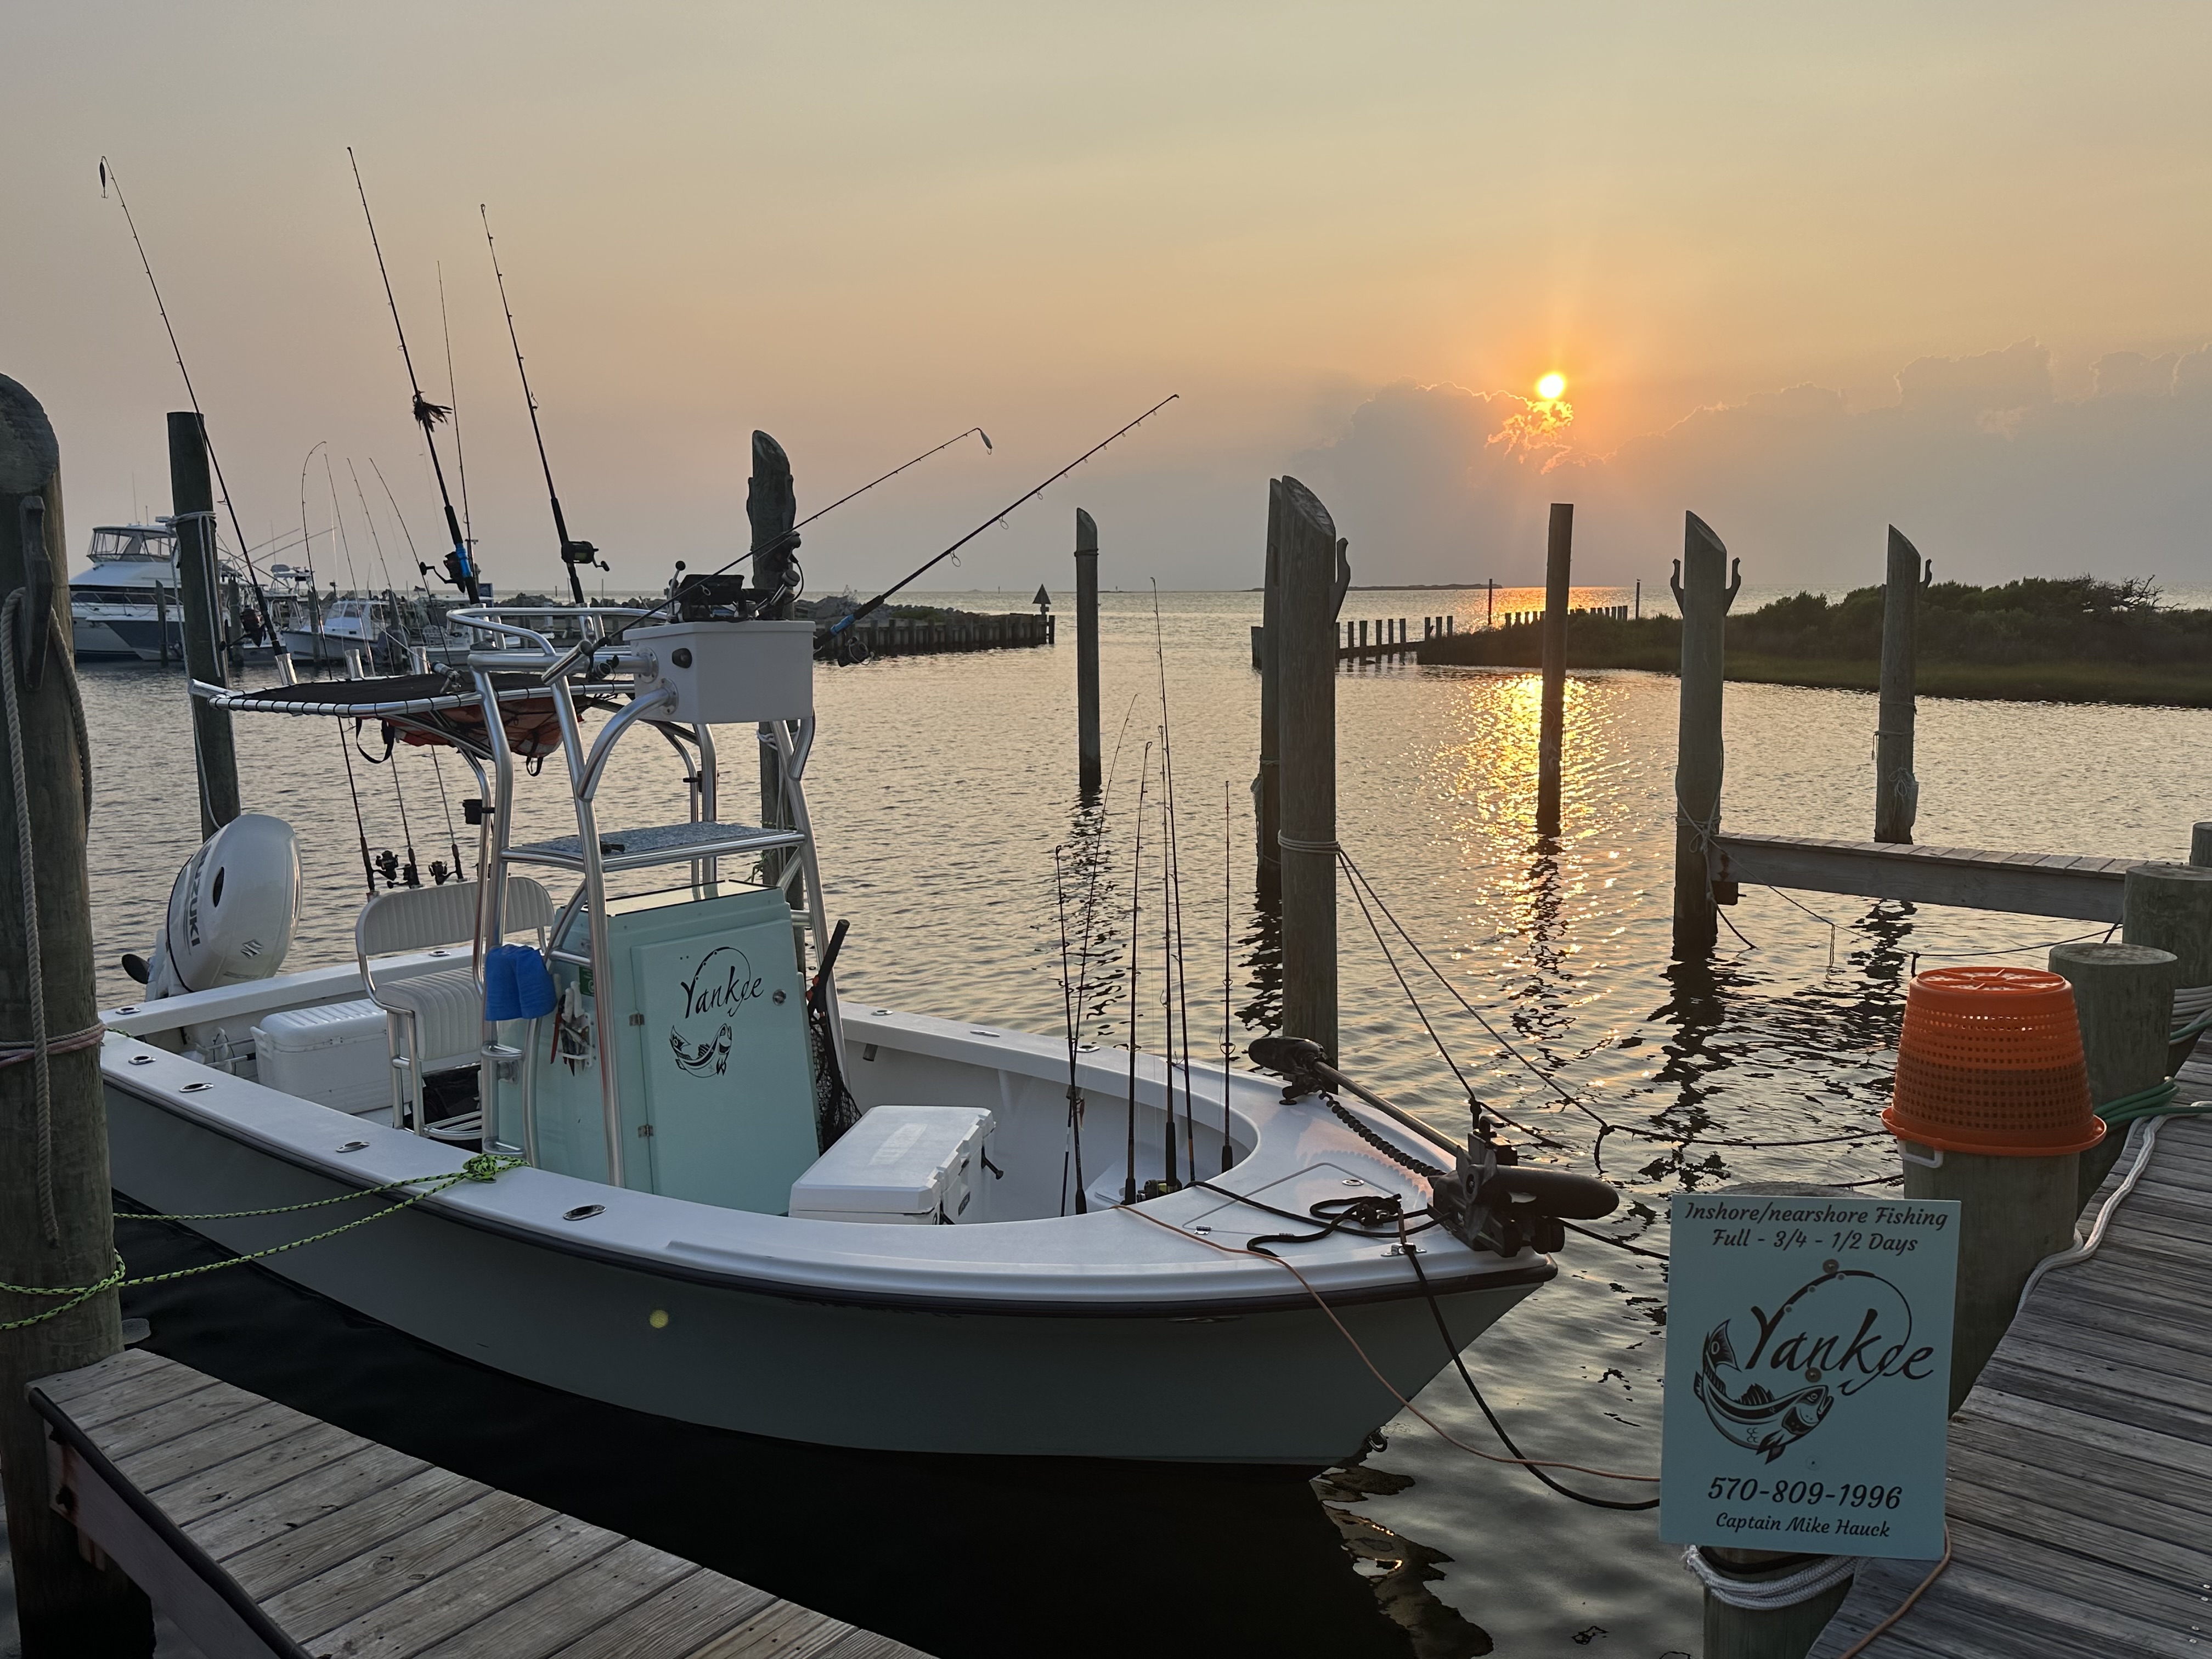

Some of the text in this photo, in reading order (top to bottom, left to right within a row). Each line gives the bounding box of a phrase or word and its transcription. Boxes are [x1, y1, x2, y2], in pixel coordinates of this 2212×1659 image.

[680, 965, 764, 1019] Yankee
[1685, 1202, 1948, 1231] Inshore/nearshore Fishing
[1712, 1228, 1751, 1246] Full
[1773, 1228, 1807, 1251] 3/4
[1831, 1229, 1863, 1252] 1/2
[1868, 1233, 1918, 1256] Days
[1745, 1306, 1934, 1381] Yankee
[1708, 1477, 1903, 1510] 570-809-1996
[1716, 1512, 1890, 1537] Captain Mike Hauck
